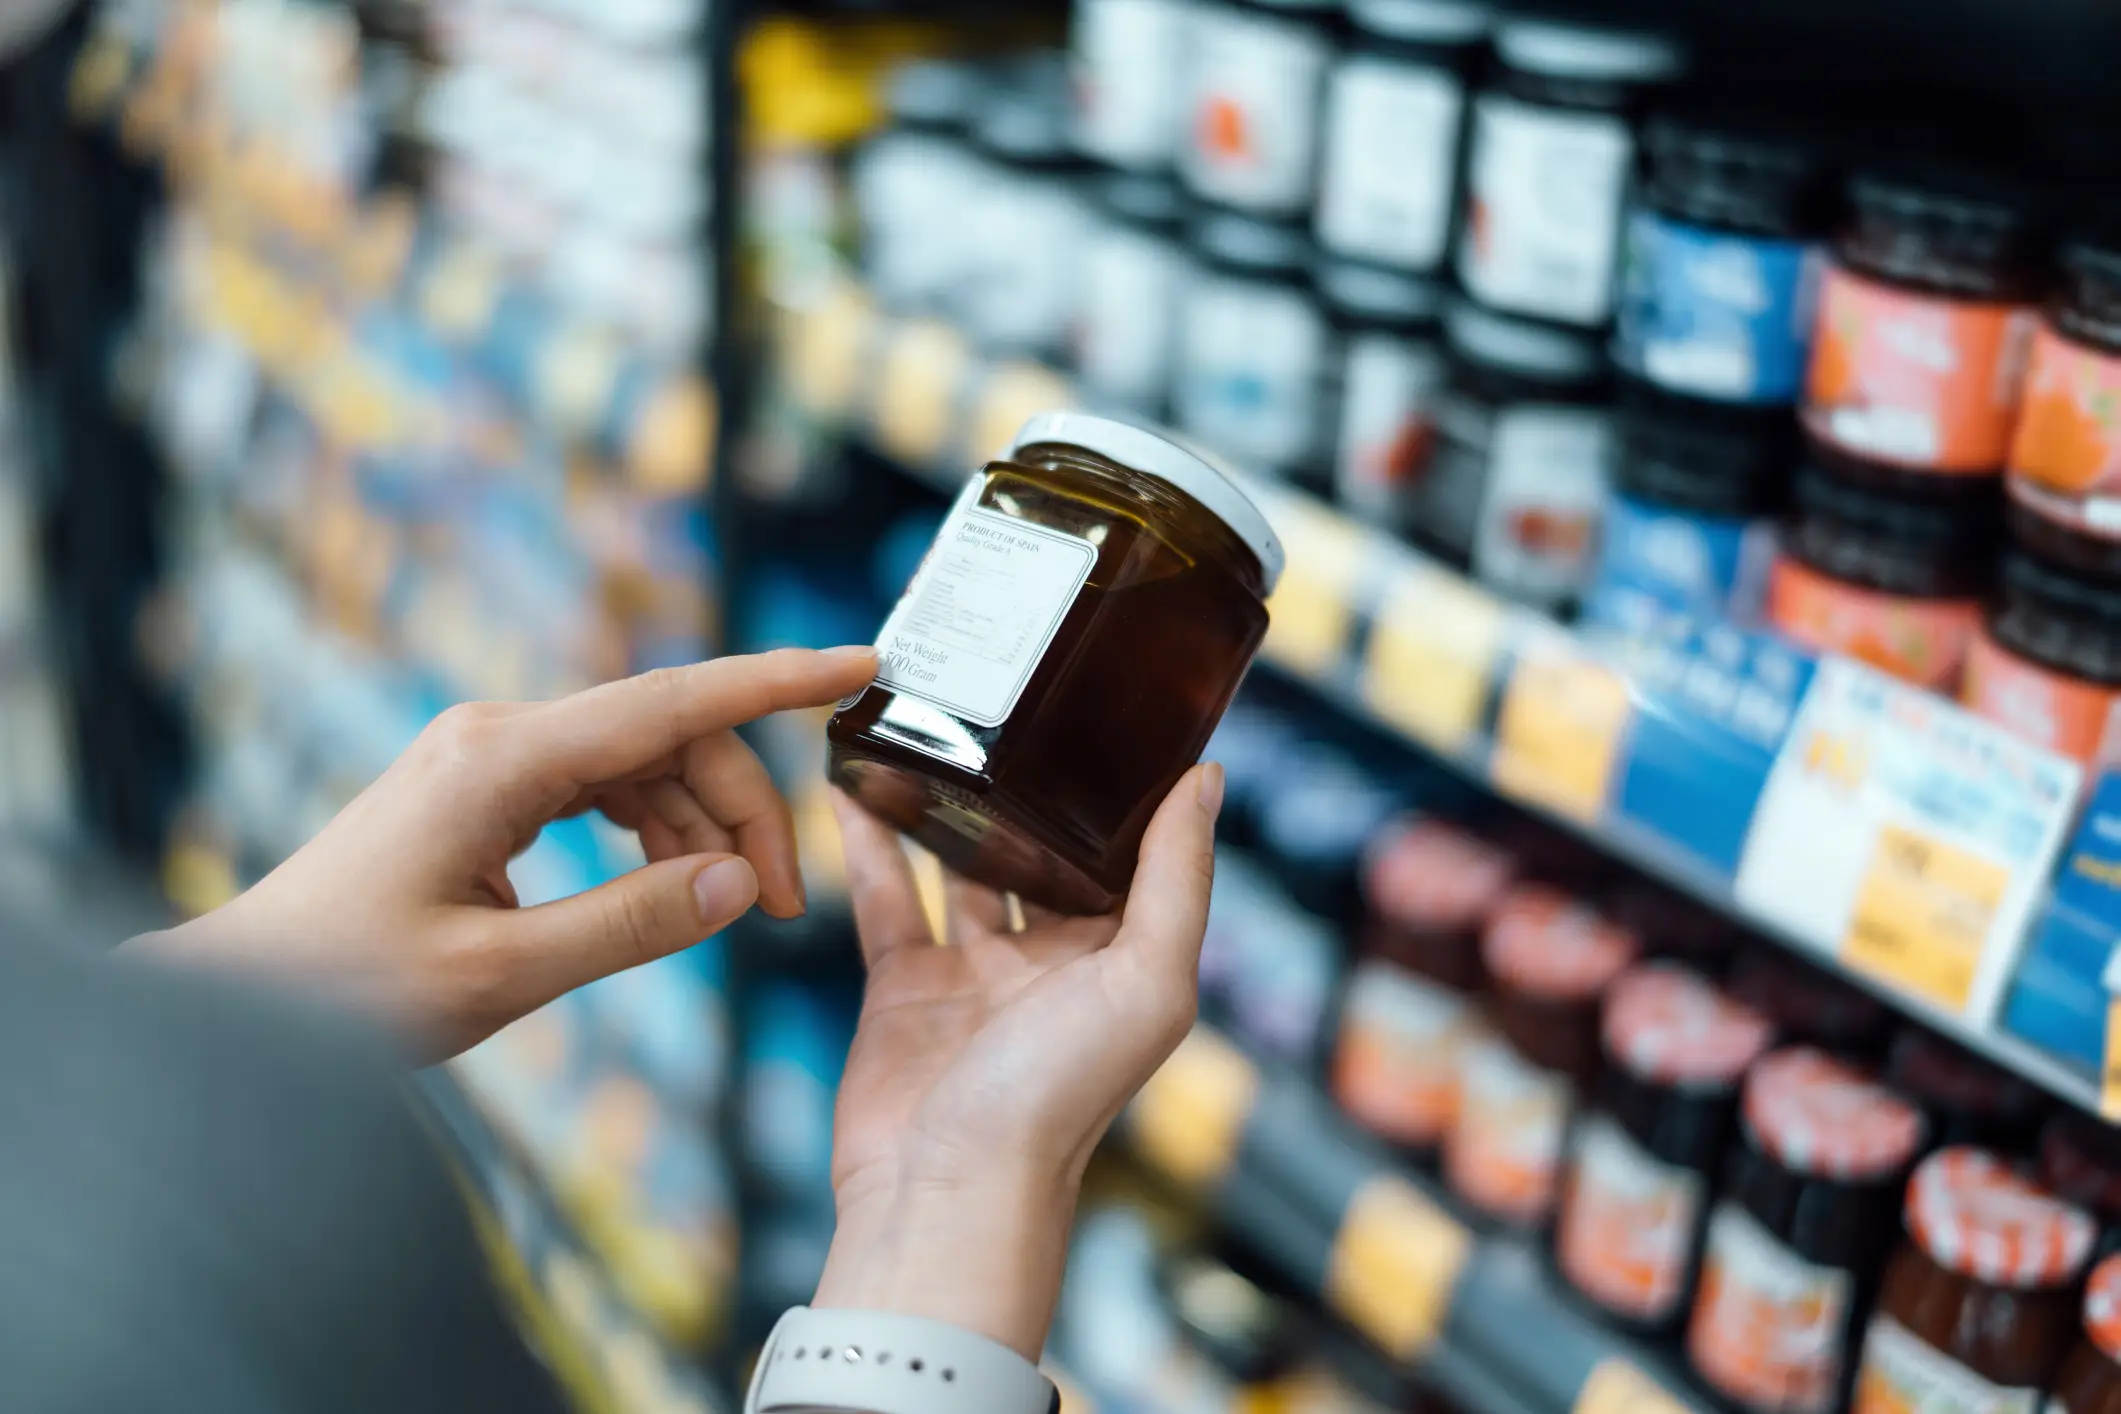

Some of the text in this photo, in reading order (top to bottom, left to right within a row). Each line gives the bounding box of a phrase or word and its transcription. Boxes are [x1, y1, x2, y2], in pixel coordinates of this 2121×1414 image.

[956, 531, 1011, 556] Quality Grade A
[962, 522, 1040, 553] PRODUCT OF SPAIN
[890, 635, 948, 664] Net Weight
[884, 651, 938, 683] 500 Gram
